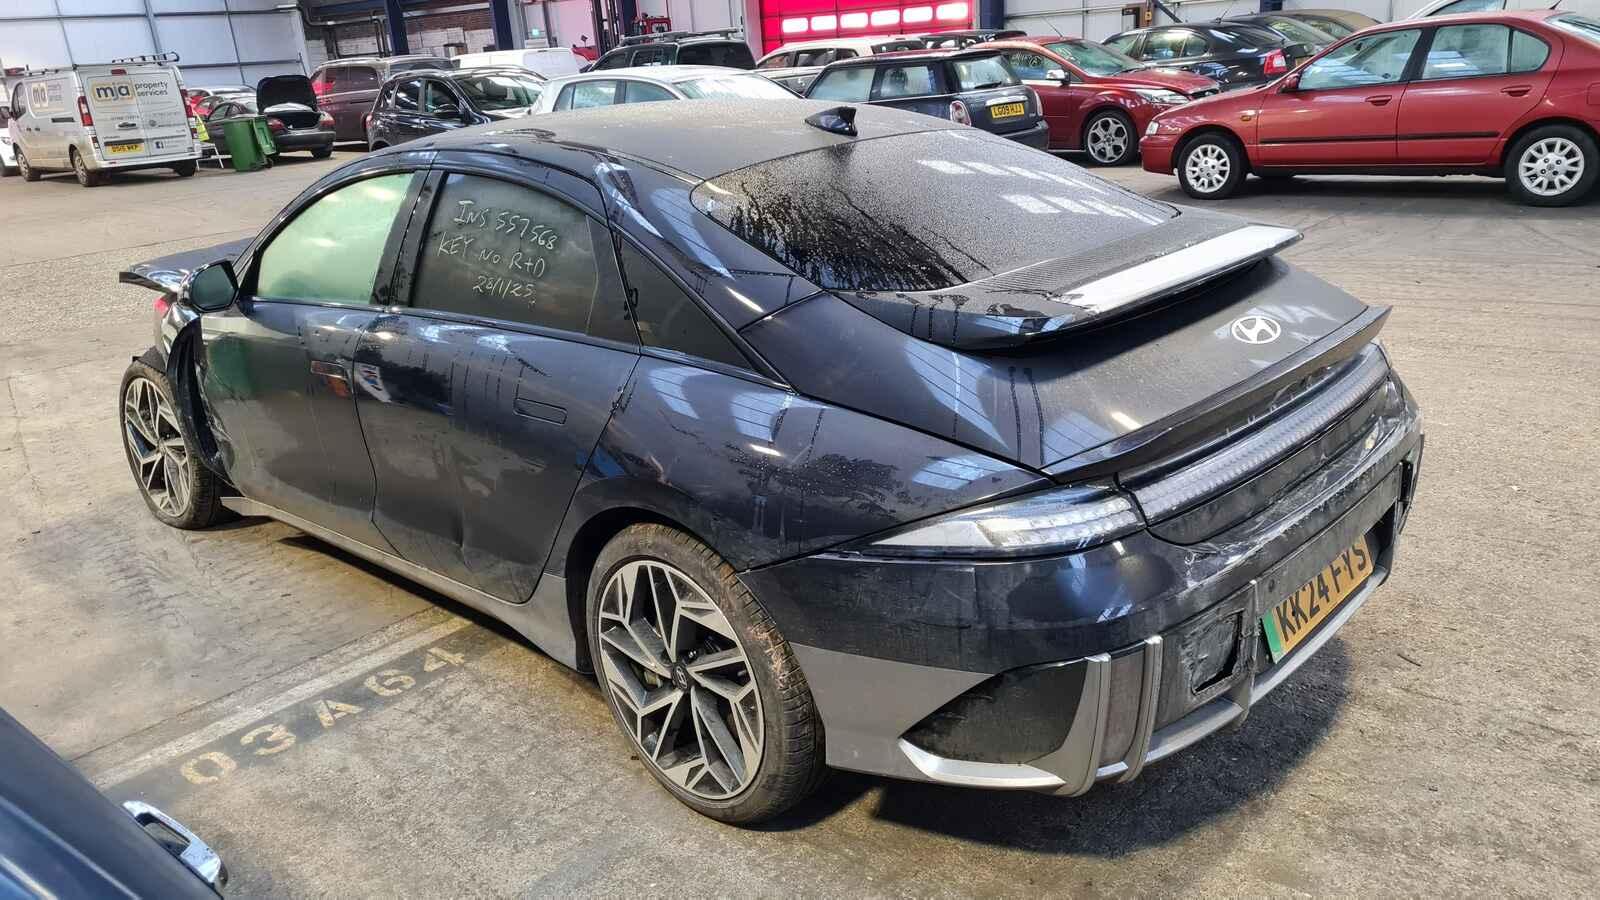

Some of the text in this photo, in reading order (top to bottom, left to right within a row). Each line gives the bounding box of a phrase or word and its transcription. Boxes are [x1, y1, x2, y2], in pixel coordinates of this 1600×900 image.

[96, 81, 130, 101] mja
[134, 81, 168, 91] property
[136, 88, 168, 97] services
[495, 212, 559, 250] 557568
[437, 231, 475, 257] KEY
[508, 251, 546, 278] R+D
[1275, 544, 1367, 642] KK24 FYS
